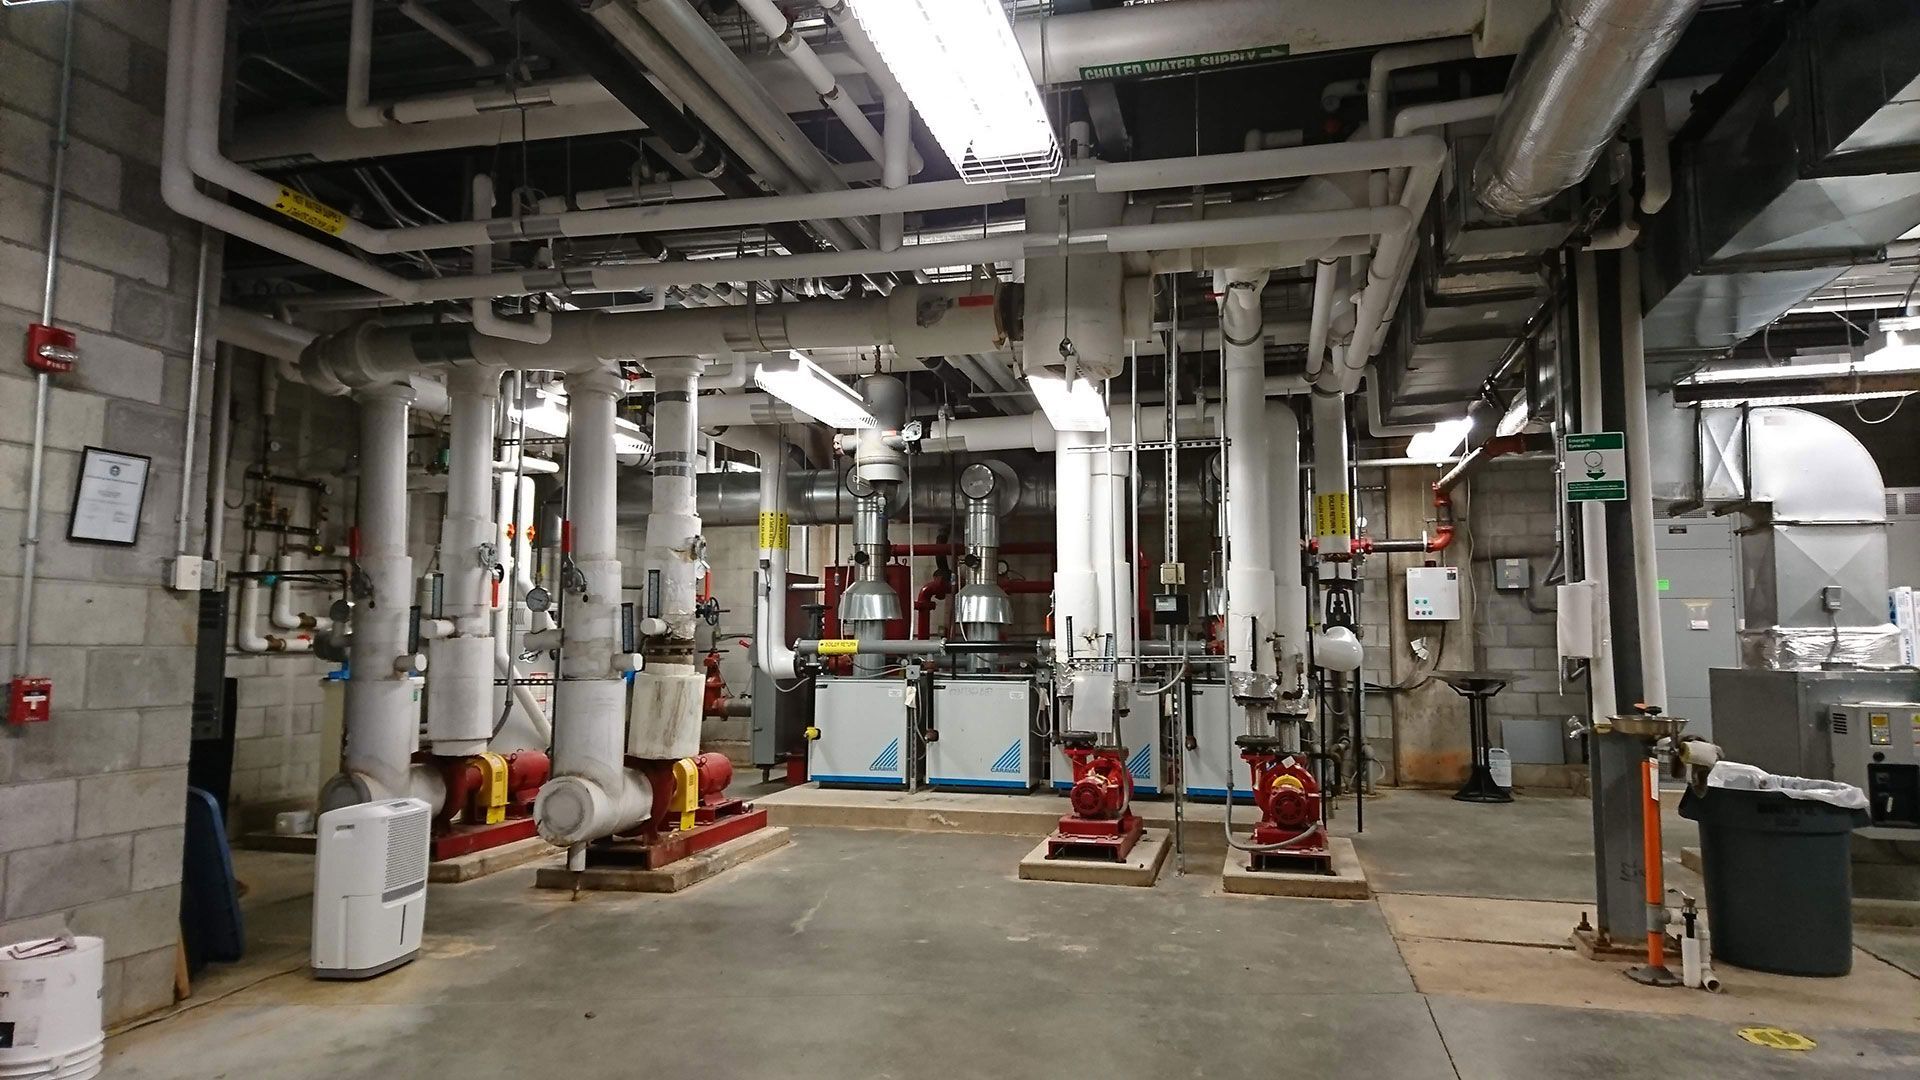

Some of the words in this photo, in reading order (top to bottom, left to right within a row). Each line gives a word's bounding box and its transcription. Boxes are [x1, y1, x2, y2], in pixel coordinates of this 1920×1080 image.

[1085, 64, 1142, 80] CHILLED
[1146, 58, 1195, 72] WATER
[1200, 50, 1256, 66] SUPPLY
